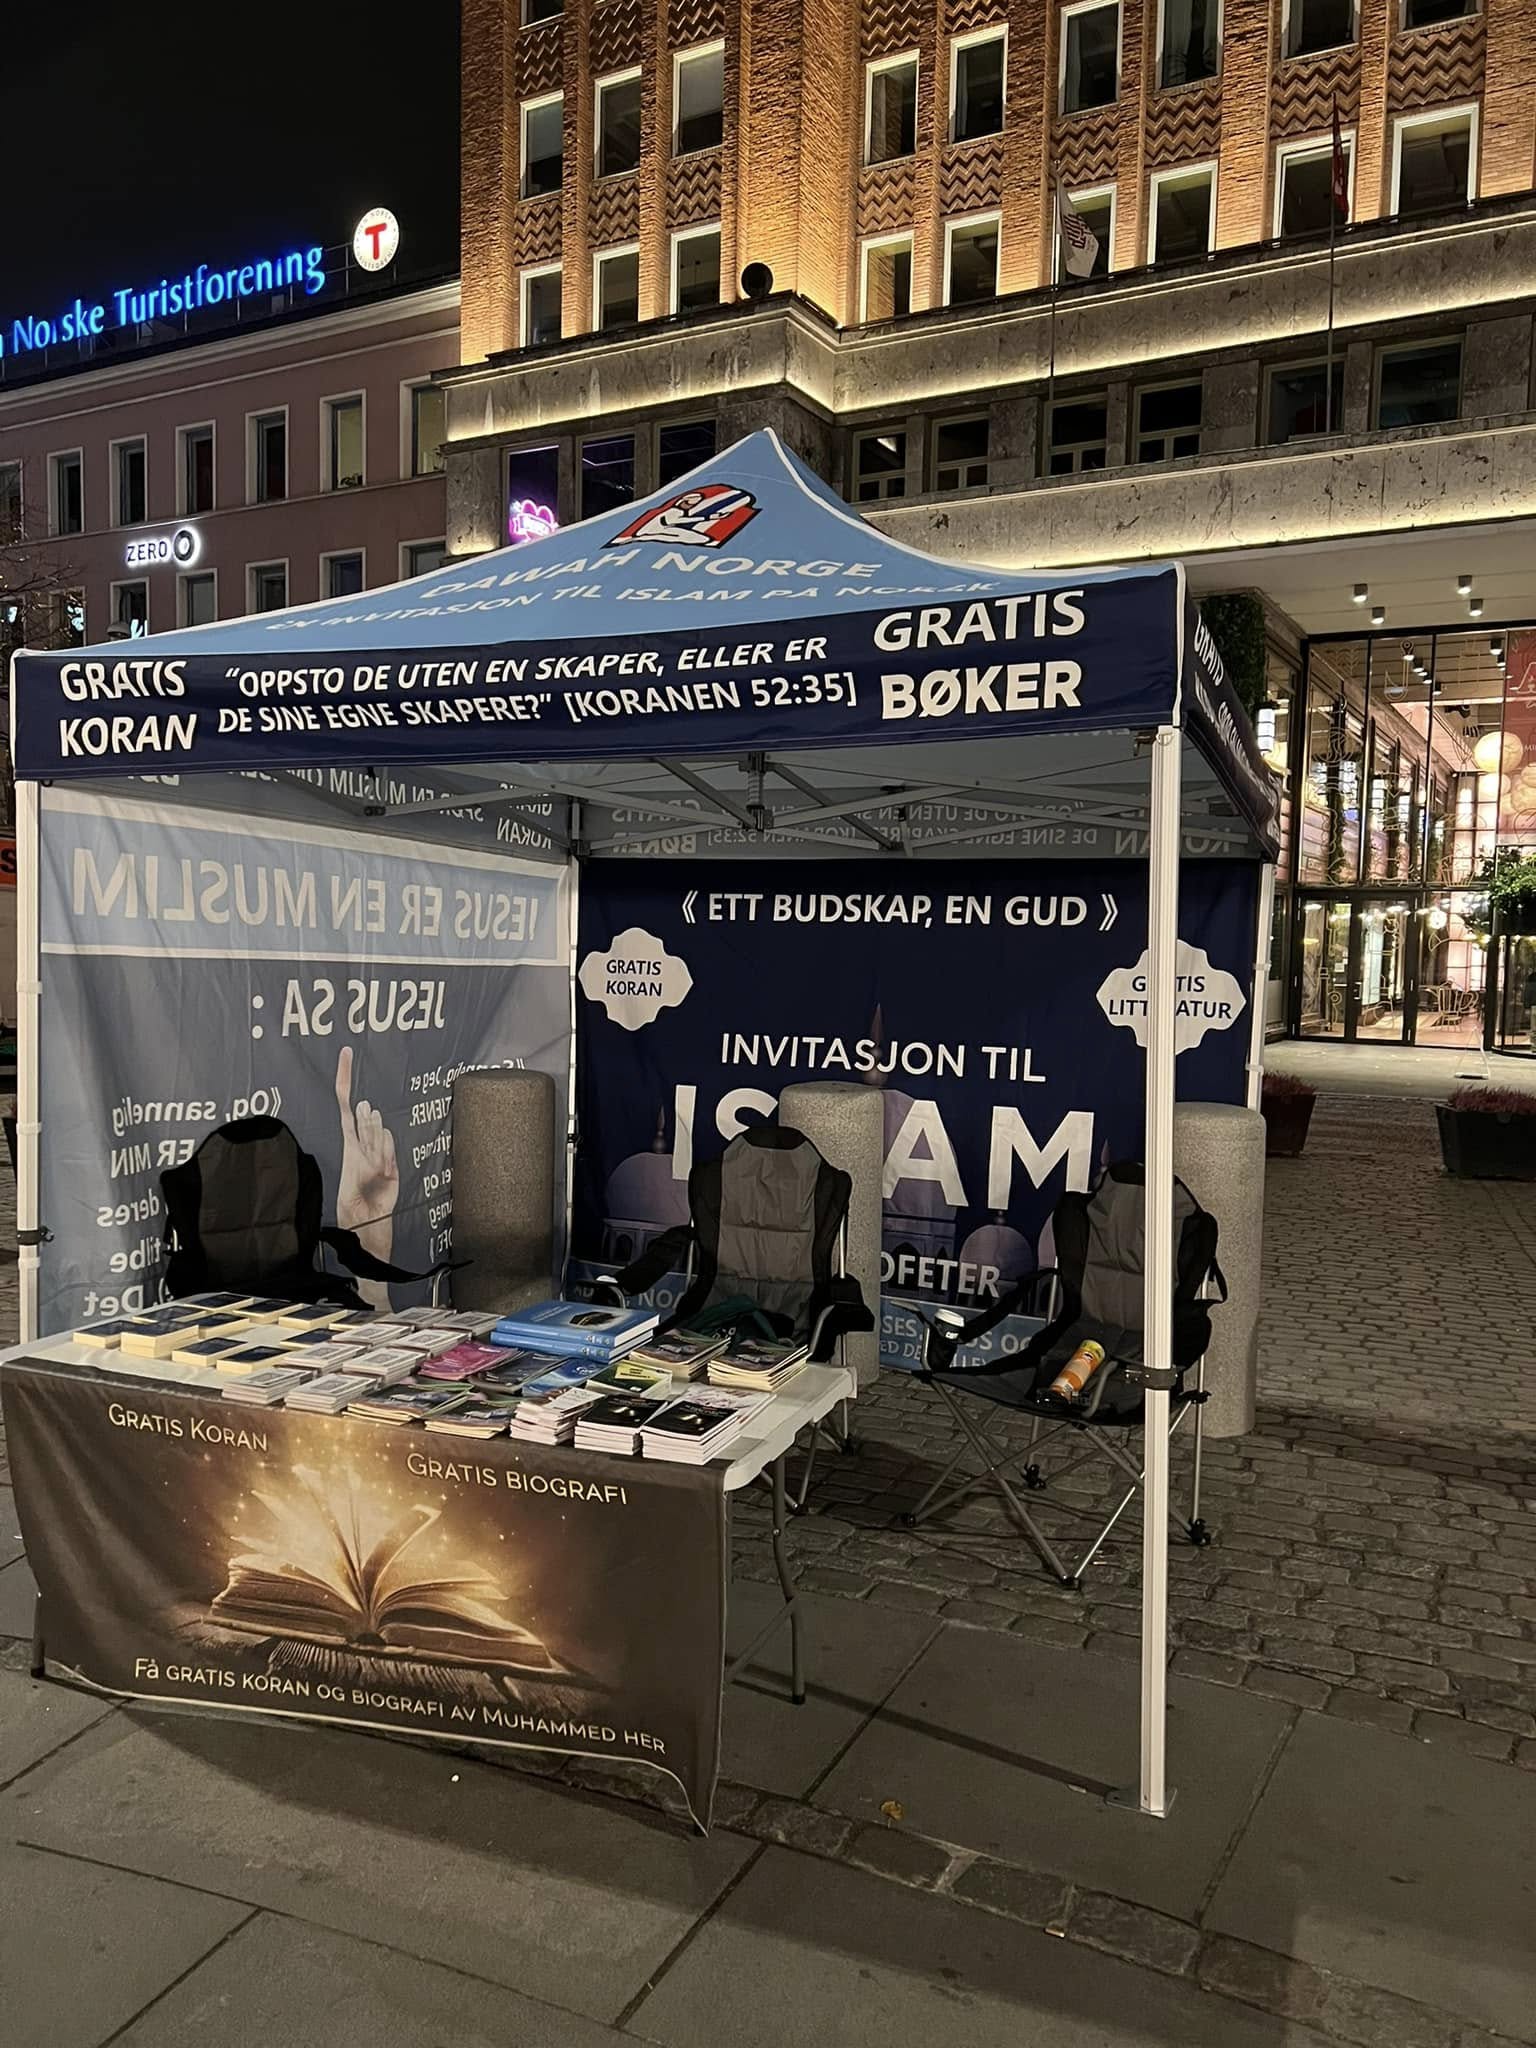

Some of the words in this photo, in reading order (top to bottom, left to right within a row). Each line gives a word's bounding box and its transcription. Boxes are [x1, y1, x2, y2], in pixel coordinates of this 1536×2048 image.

[365, 222, 388, 260] T
[114, 246, 326, 326] Turistforening
[127, 541, 168, 562] ZERO
[420, 549, 641, 599] DAWAH
[652, 551, 882, 578] NORGE
[320, 592, 544, 626] INVITASJON
[551, 584, 600, 600] TIL
[616, 587, 753, 601] ISLAM
[761, 586, 820, 599] PÅ
[873, 590, 1086, 652] GRATIS
[60, 660, 187, 702] GRATIS
[354, 665, 391, 690] DE
[398, 661, 477, 688] UTEN
[484, 659, 524, 683] EN
[535, 652, 665, 682] SKAPER,
[677, 642, 772, 671] ELLER
[784, 637, 828, 661] ER
[217, 707, 253, 734] DE
[260, 704, 320, 732] SINE
[327, 701, 399, 729] EGNE
[565, 681, 750, 723] [KORANEN
[753, 672, 858, 708] 52:35]
[880, 660, 1083, 720] BØKER
[60, 714, 197, 756] KORAN
[708, 893, 765, 922] ETT
[772, 894, 934, 929] BUDSKAP,
[945, 895, 992, 925] EN
[1003, 896, 1089, 927] GUD
[605, 958, 662, 977] GRATIS
[605, 979, 663, 997] KORAN
[1132, 975, 1206, 993] GTIS
[1108, 999, 1233, 1020] LITTATUR
[720, 1032, 967, 1078] INVITASJON
[981, 1046, 1047, 1083] TIL
[506, 1470, 628, 1506] BIOGRAFI
[166, 1665, 237, 1689] GRATIS
[242, 1674, 311, 1698] KORAN
[317, 1684, 346, 1702] OG
[353, 1689, 445, 1718] BIOGRAFI
[451, 1705, 477, 1721] AV
[624, 1730, 666, 1753] HER
